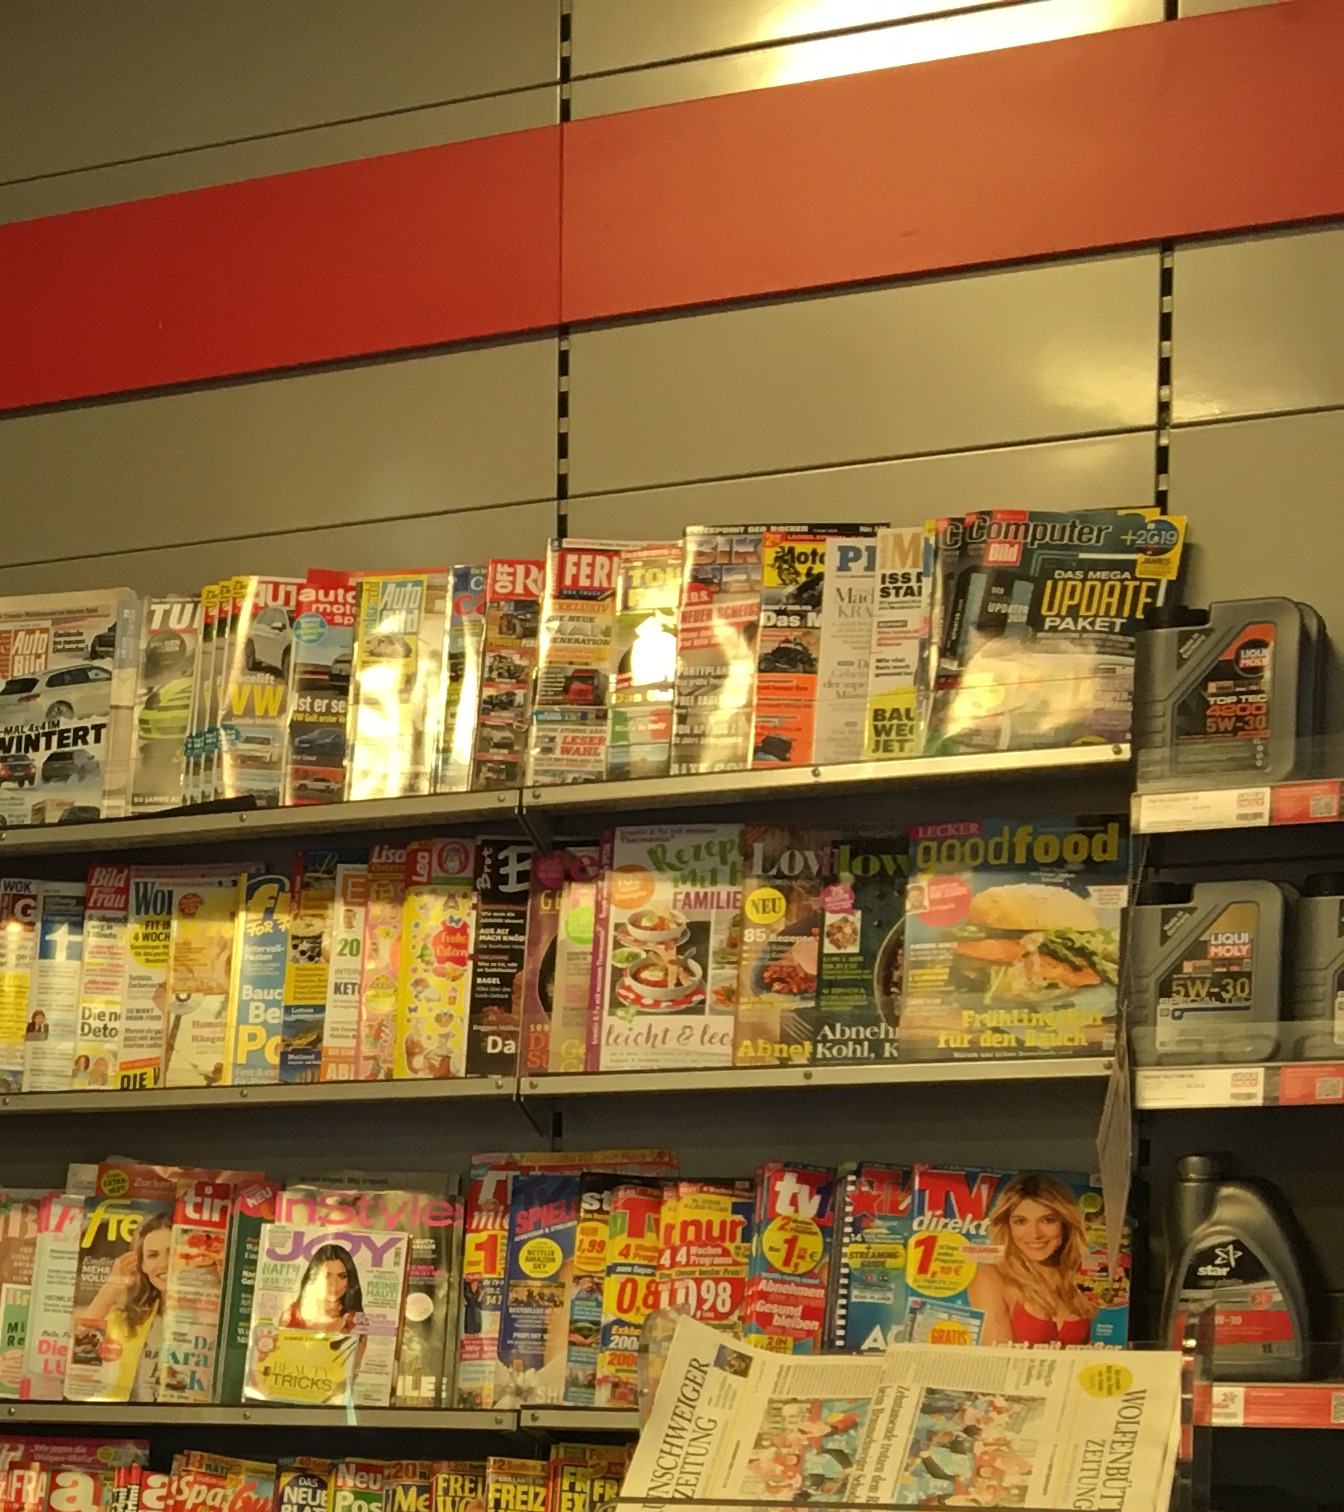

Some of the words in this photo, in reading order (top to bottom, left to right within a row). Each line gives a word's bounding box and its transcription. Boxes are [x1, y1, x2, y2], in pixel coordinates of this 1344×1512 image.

[967, 517, 1112, 549] Computer
[1054, 569, 1085, 580] DAS
[1087, 569, 1132, 580] MEGA
[1040, 580, 1157, 619] UPDATE
[1044, 616, 1127, 633] PAKET
[13, 628, 48, 655] Auto
[230, 684, 285, 717] VW
[1207, 694, 1234, 705] TOP
[1236, 693, 1267, 703] TEC
[1205, 702, 1267, 716] 4200
[1205, 716, 1267, 732] 5W-30
[918, 822, 979, 838] LECKER
[372, 846, 406, 863] Lisa
[89, 867, 127, 888] Bild
[3, 880, 32, 894] WOK
[750, 898, 781, 915] NEU
[744, 929, 766, 942] 85
[1210, 933, 1249, 945] LIQUI
[337, 938, 360, 957] 20
[1211, 945, 1251, 959] MOLY
[1171, 977, 1251, 1000] 5W-30
[962, 1009, 1105, 1028] Frühlingskur
[938, 1031, 975, 1049] für
[980, 1031, 1016, 1048] den
[1025, 1031, 1088, 1048] Bauch
[918, 1173, 1001, 1221] TV
[912, 1210, 991, 1236] direkt
[266, 1230, 404, 1268] JOY
[526, 1249, 556, 1257] NETFLIX
[577, 1238, 606, 1255] 1,99
[1197, 1262, 1231, 1277] star
[758, 1279, 825, 1298] Abnehmen
[754, 1299, 802, 1317] Gesund
[772, 1313, 819, 1331] bleiben
[273, 1376, 332, 1391] TRICKS
[671, 1416, 719, 1501] ZEITUNG
[299, 1477, 318, 1487] DAS
